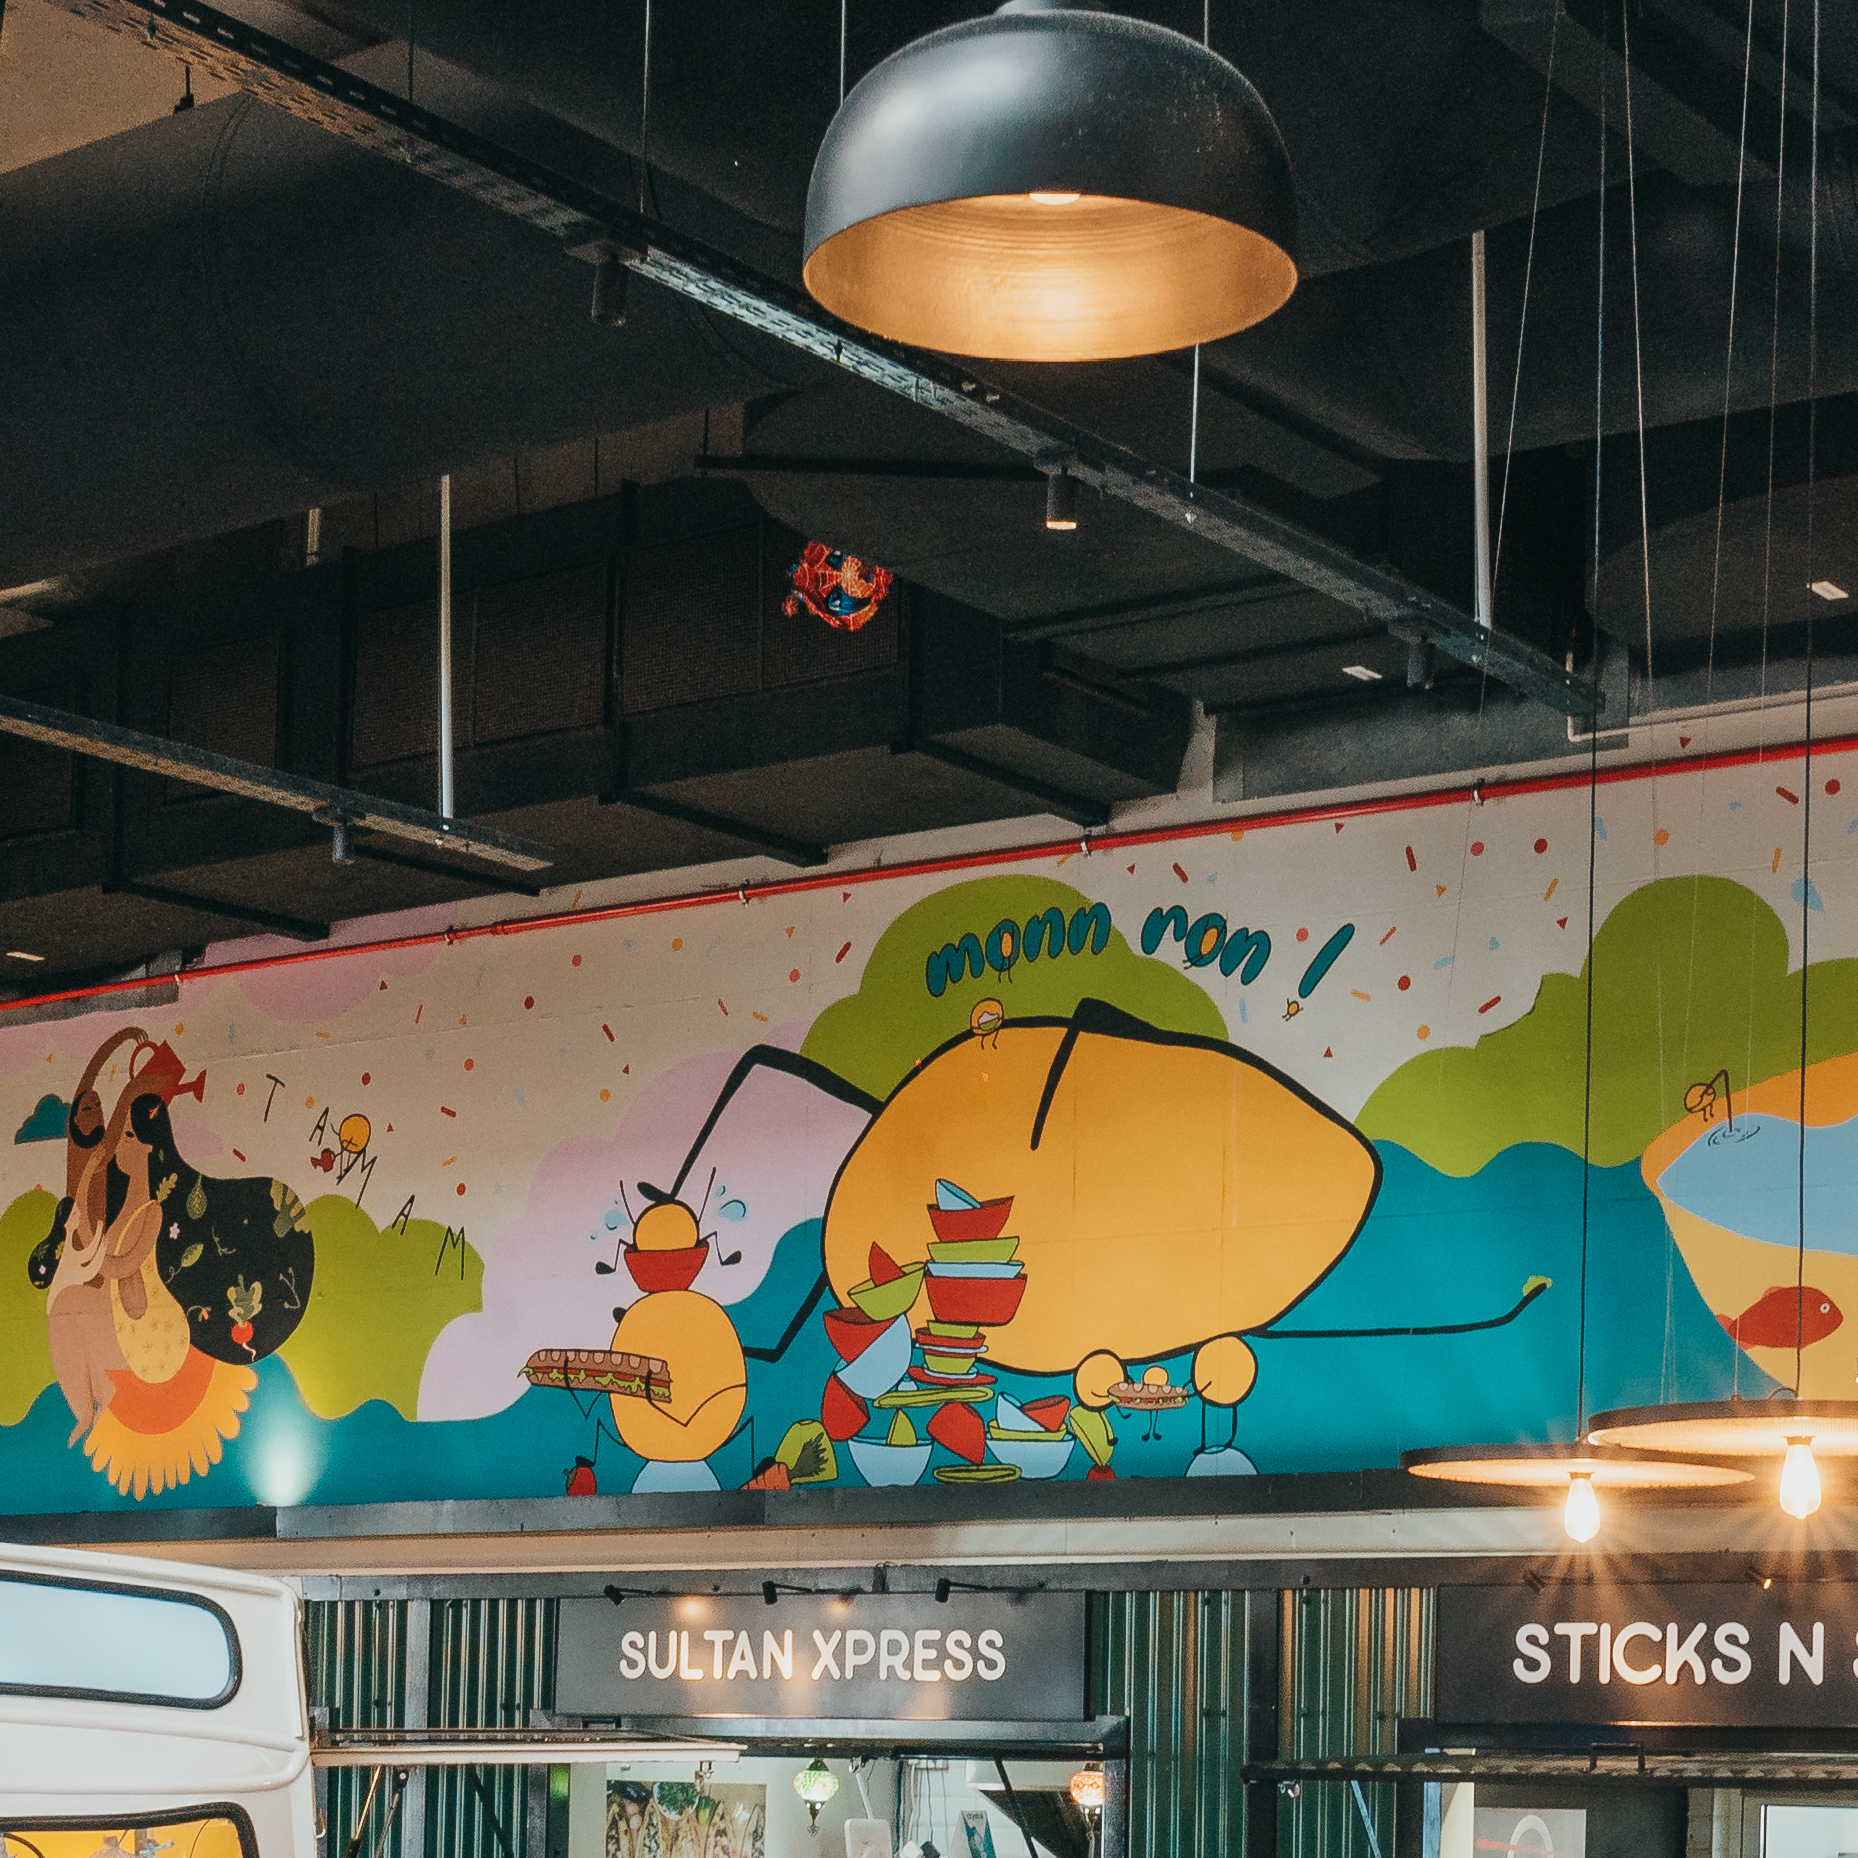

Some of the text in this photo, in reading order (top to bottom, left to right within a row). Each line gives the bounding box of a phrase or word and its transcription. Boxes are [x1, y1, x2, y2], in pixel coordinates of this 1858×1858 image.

[1141, 904, 1273, 987] ron
[618, 1628, 1007, 1682] SULTAN XPRESS
[1512, 1620, 1752, 1686] STICKS
[1777, 1621, 1826, 1686] N
